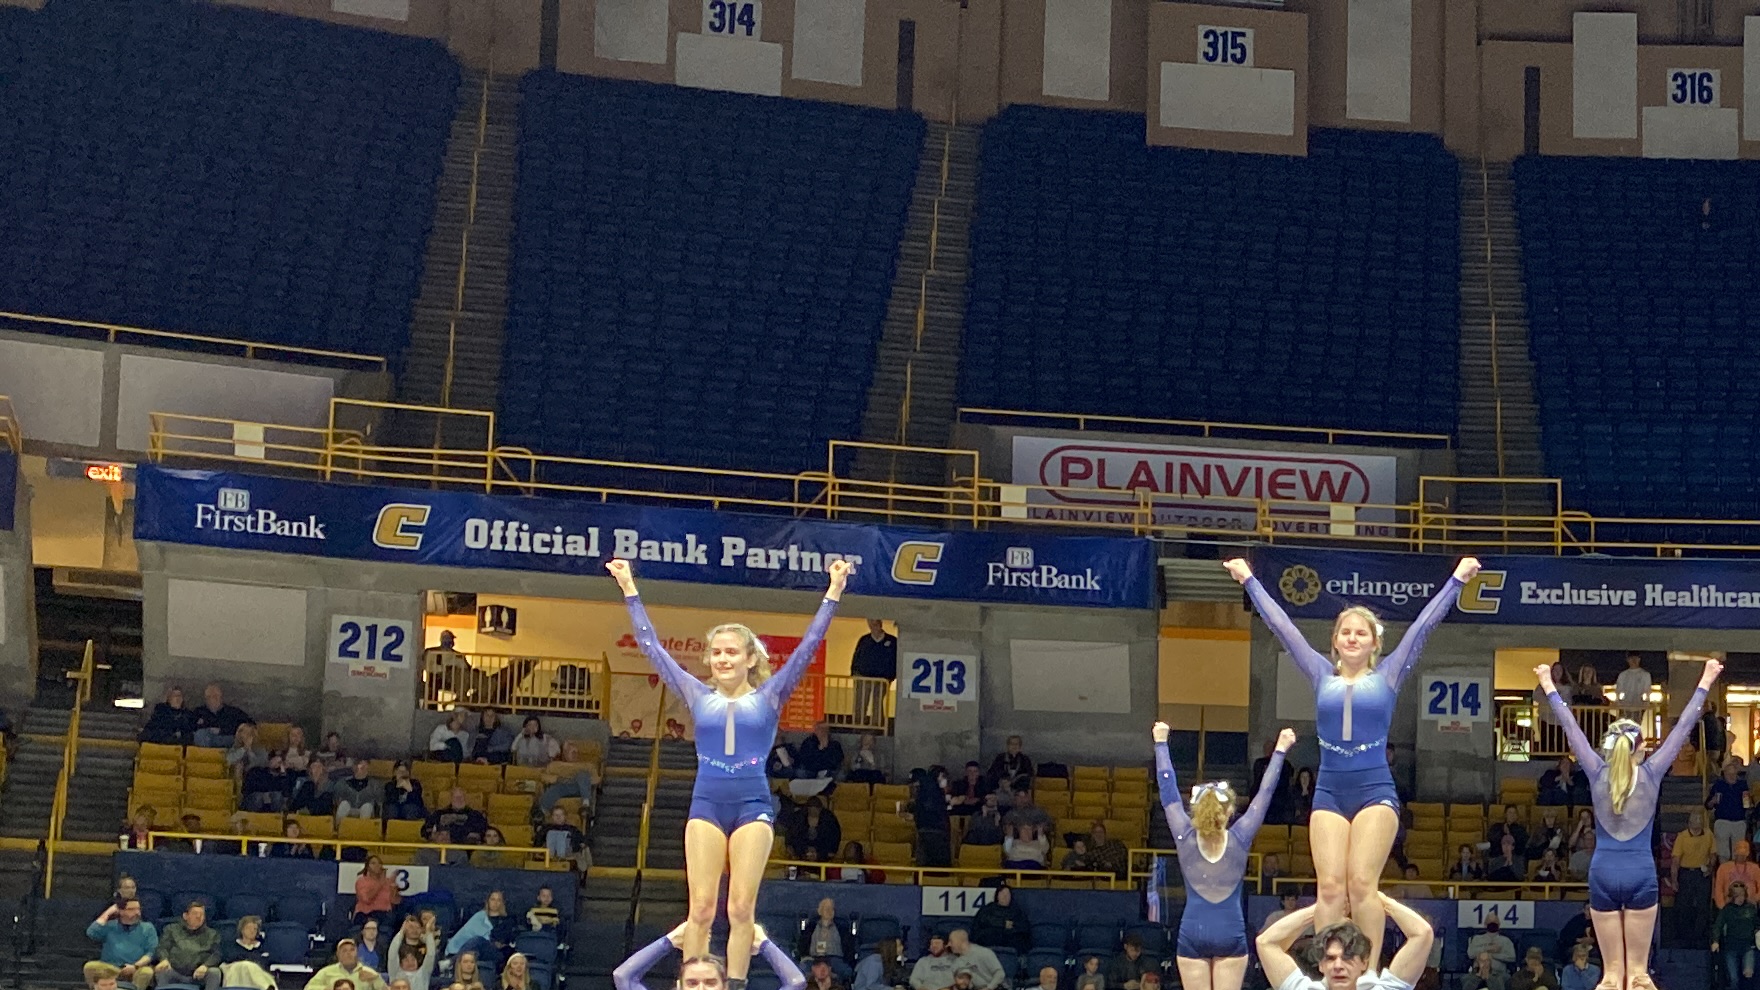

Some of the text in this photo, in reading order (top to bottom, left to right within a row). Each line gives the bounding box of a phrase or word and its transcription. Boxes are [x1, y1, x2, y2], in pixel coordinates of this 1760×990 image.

[709, 0, 755, 36] 314
[1203, 29, 1247, 64] 315
[1672, 72, 1713, 104] 316
[86, 464, 123, 482] exit
[1060, 455, 1352, 503] PLAINVIEW
[222, 491, 247, 509] FB
[1027, 508, 1134, 524] LAINVIEW
[195, 503, 326, 539] FirstBank
[373, 503, 431, 550] C
[465, 518, 600, 557] Official
[613, 528, 708, 564] Bank
[891, 540, 945, 585] C
[1010, 551, 1031, 566] FB
[986, 562, 1101, 591] FirstBank
[1326, 572, 1435, 606] erlanger
[1520, 581, 1637, 607] Exclusive
[338, 621, 405, 662] 212
[911, 658, 966, 695] 213
[1429, 681, 1481, 716] 214
[938, 890, 987, 913] 114
[1473, 903, 1520, 926] 114
